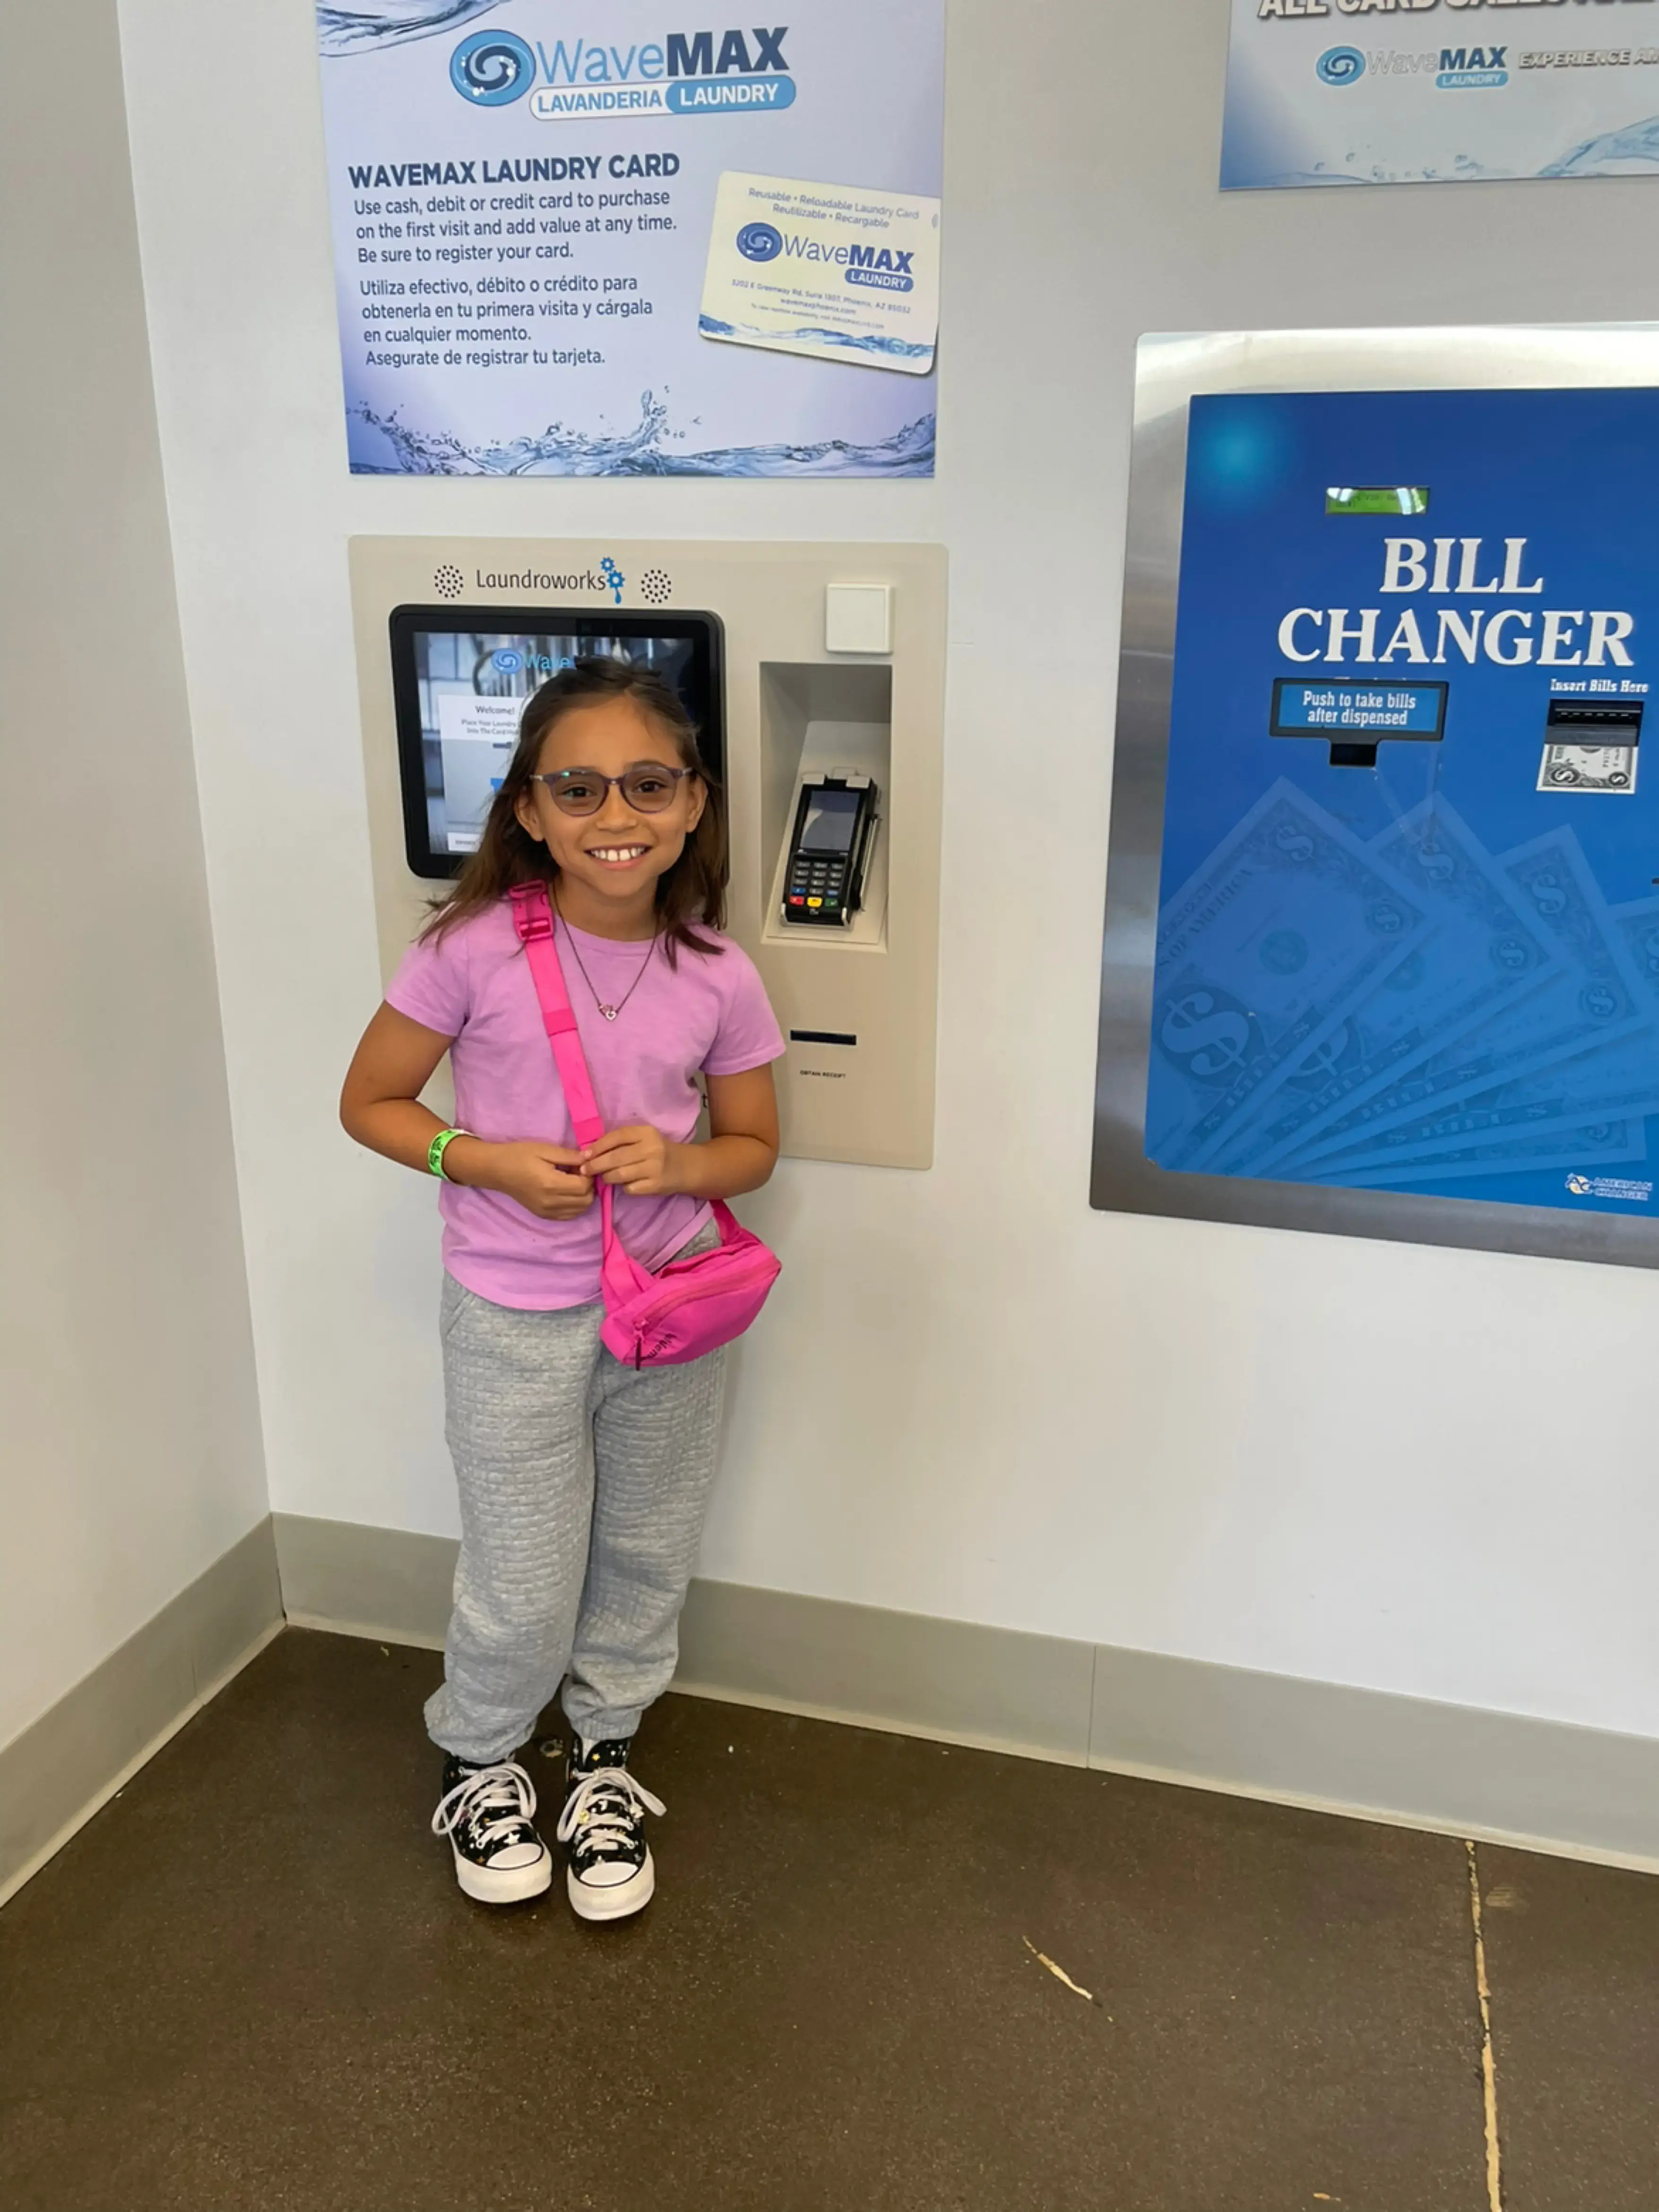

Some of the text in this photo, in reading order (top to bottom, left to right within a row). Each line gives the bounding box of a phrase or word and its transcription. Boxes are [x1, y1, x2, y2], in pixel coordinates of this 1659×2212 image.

[536, 26, 789, 85] WaveMAX
[1366, 46, 1508, 75] WaveMAX
[1518, 50, 1630, 68] EXPERIENCE
[1442, 73, 1502, 86] LAUNDRY
[538, 83, 779, 113] LAVANDERIA LAUNDRY
[348, 153, 680, 188] WAVEMAX LAUNDRY CARD
[354, 189, 670, 216] Use cash, debit or credit card to purchase
[749, 187, 919, 220] Reusable Reloadable Laundry Card
[356, 214, 677, 239] on the first visit and add value at any time.
[772, 203, 890, 228] Reutilizable Recargable
[358, 241, 574, 263] Be sure to register your card.
[784, 233, 914, 274] WaveMAX
[360, 274, 638, 296] Utiliza efectivo, débito o crédito para
[850, 270, 907, 289] LAUNDRY
[362, 298, 653, 320] obtenerla en tu primera visita y cárgala
[363, 325, 532, 345] en cualquier momento.
[365, 347, 605, 368] Asegurate de registrar tu tarjeta.
[1379, 538, 1544, 594] BILL
[475, 568, 606, 590] Laundroworks
[1278, 607, 1635, 667] CHANGER
[1550, 679, 1649, 693] Insert Bills Here
[1303, 690, 1416, 709] Push to take bills
[1307, 708, 1408, 728] after dispensed
